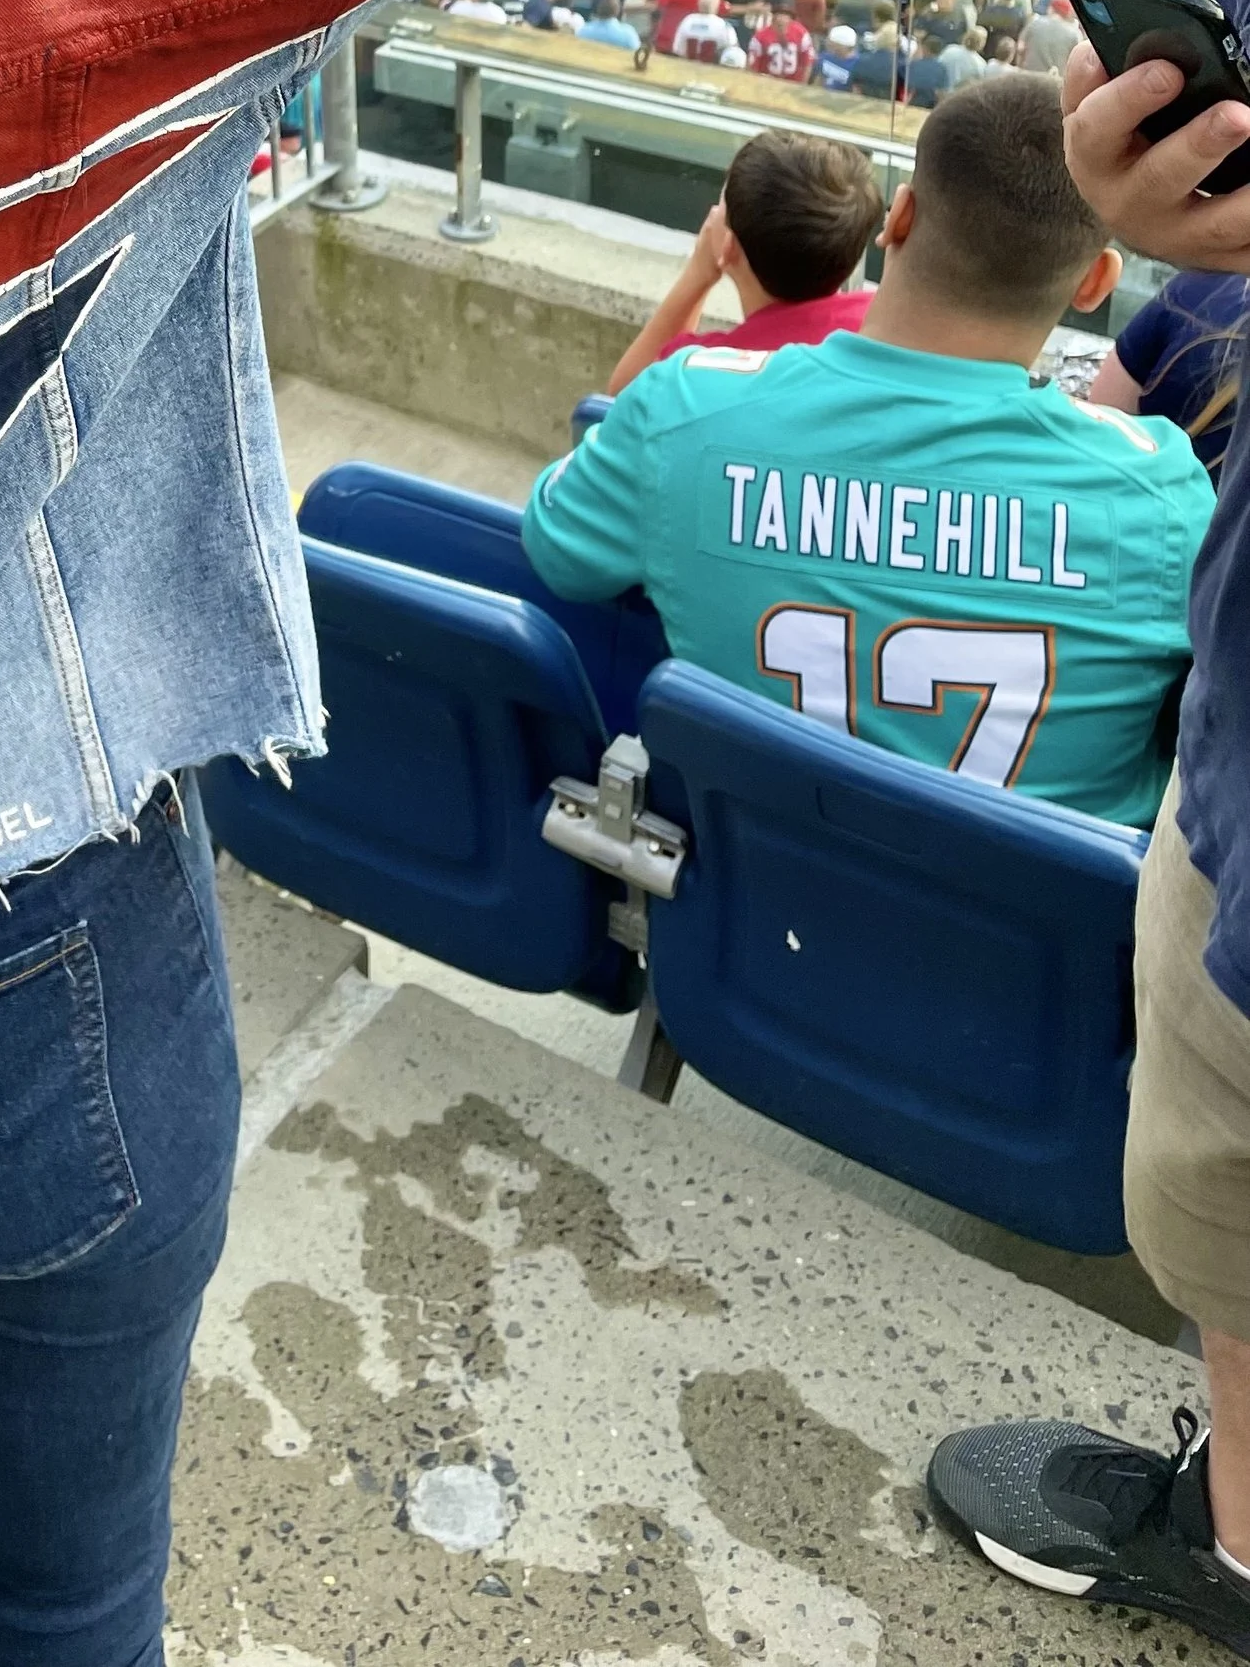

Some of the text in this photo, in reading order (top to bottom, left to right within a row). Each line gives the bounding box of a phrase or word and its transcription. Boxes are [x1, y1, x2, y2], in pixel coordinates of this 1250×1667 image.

[766, 42, 798, 76] 39
[723, 463, 1087, 590] TANNEHILL
[756, 601, 1056, 792] 17
